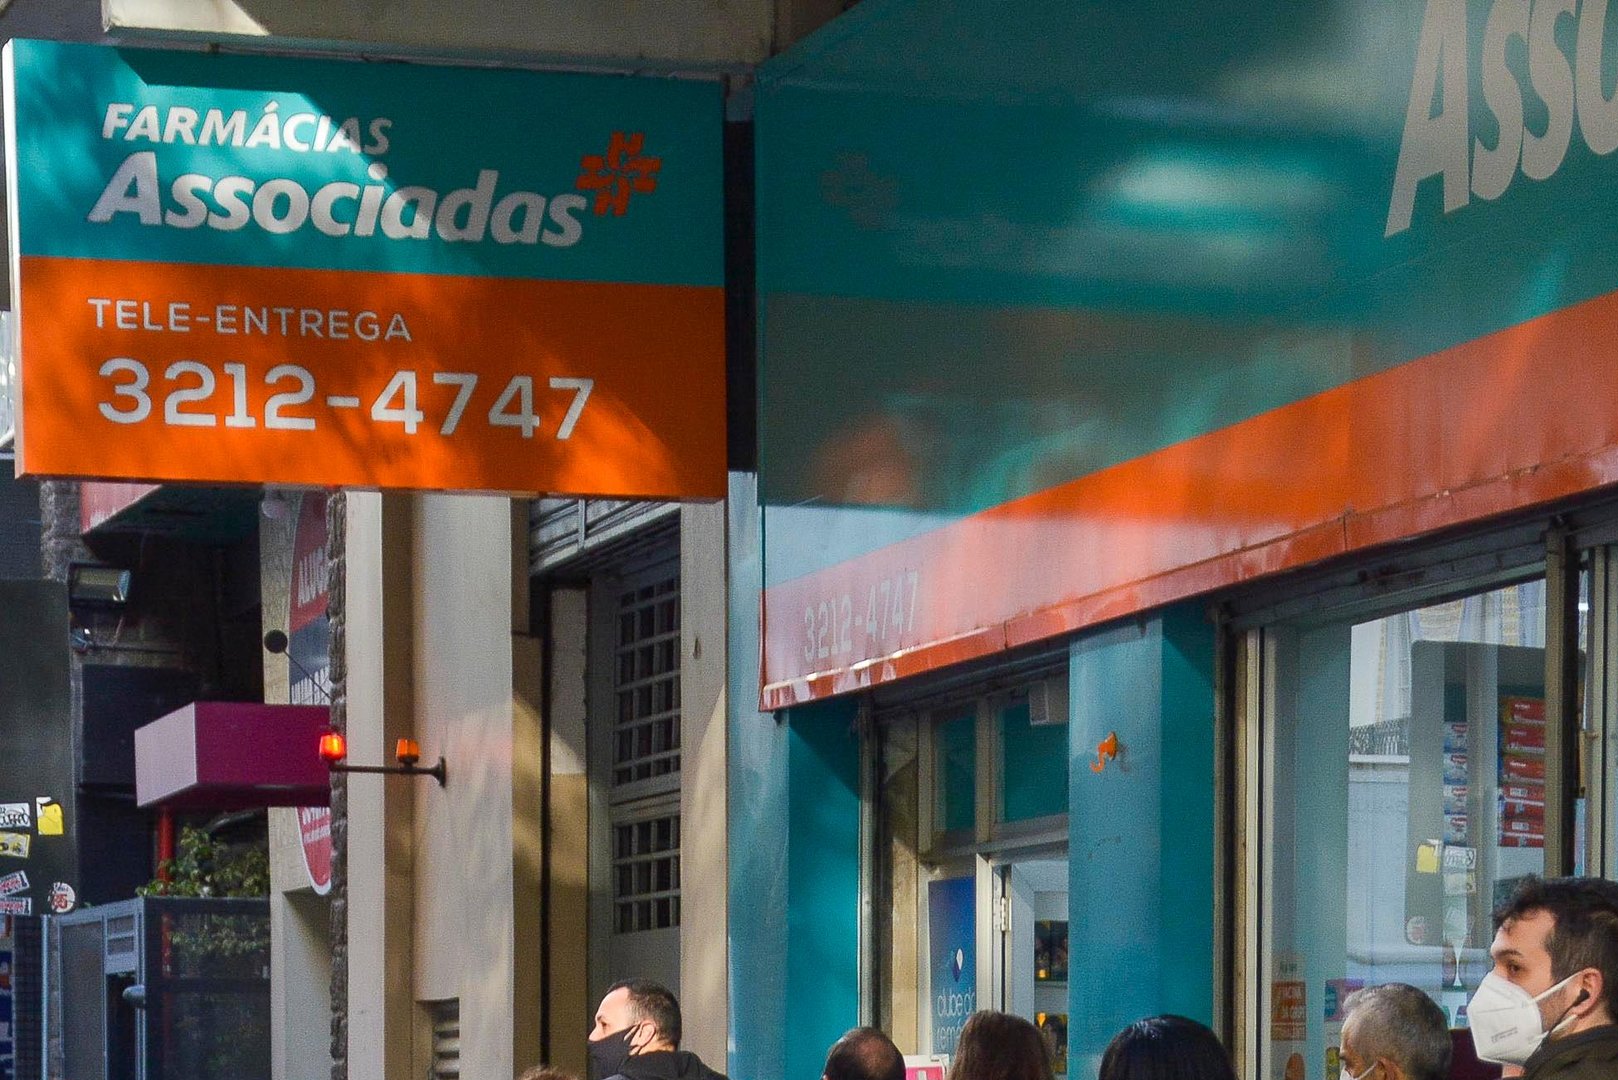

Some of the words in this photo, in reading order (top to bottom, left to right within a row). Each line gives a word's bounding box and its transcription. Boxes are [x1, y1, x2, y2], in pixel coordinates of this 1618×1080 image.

[100, 101, 392, 156] FARMÁCIAS
[88, 150, 588, 248] Associadas
[88, 297, 413, 343] TELE-ENTREGA
[97, 356, 596, 441] 3212-4747
[804, 570, 919, 664] 3212-4747
